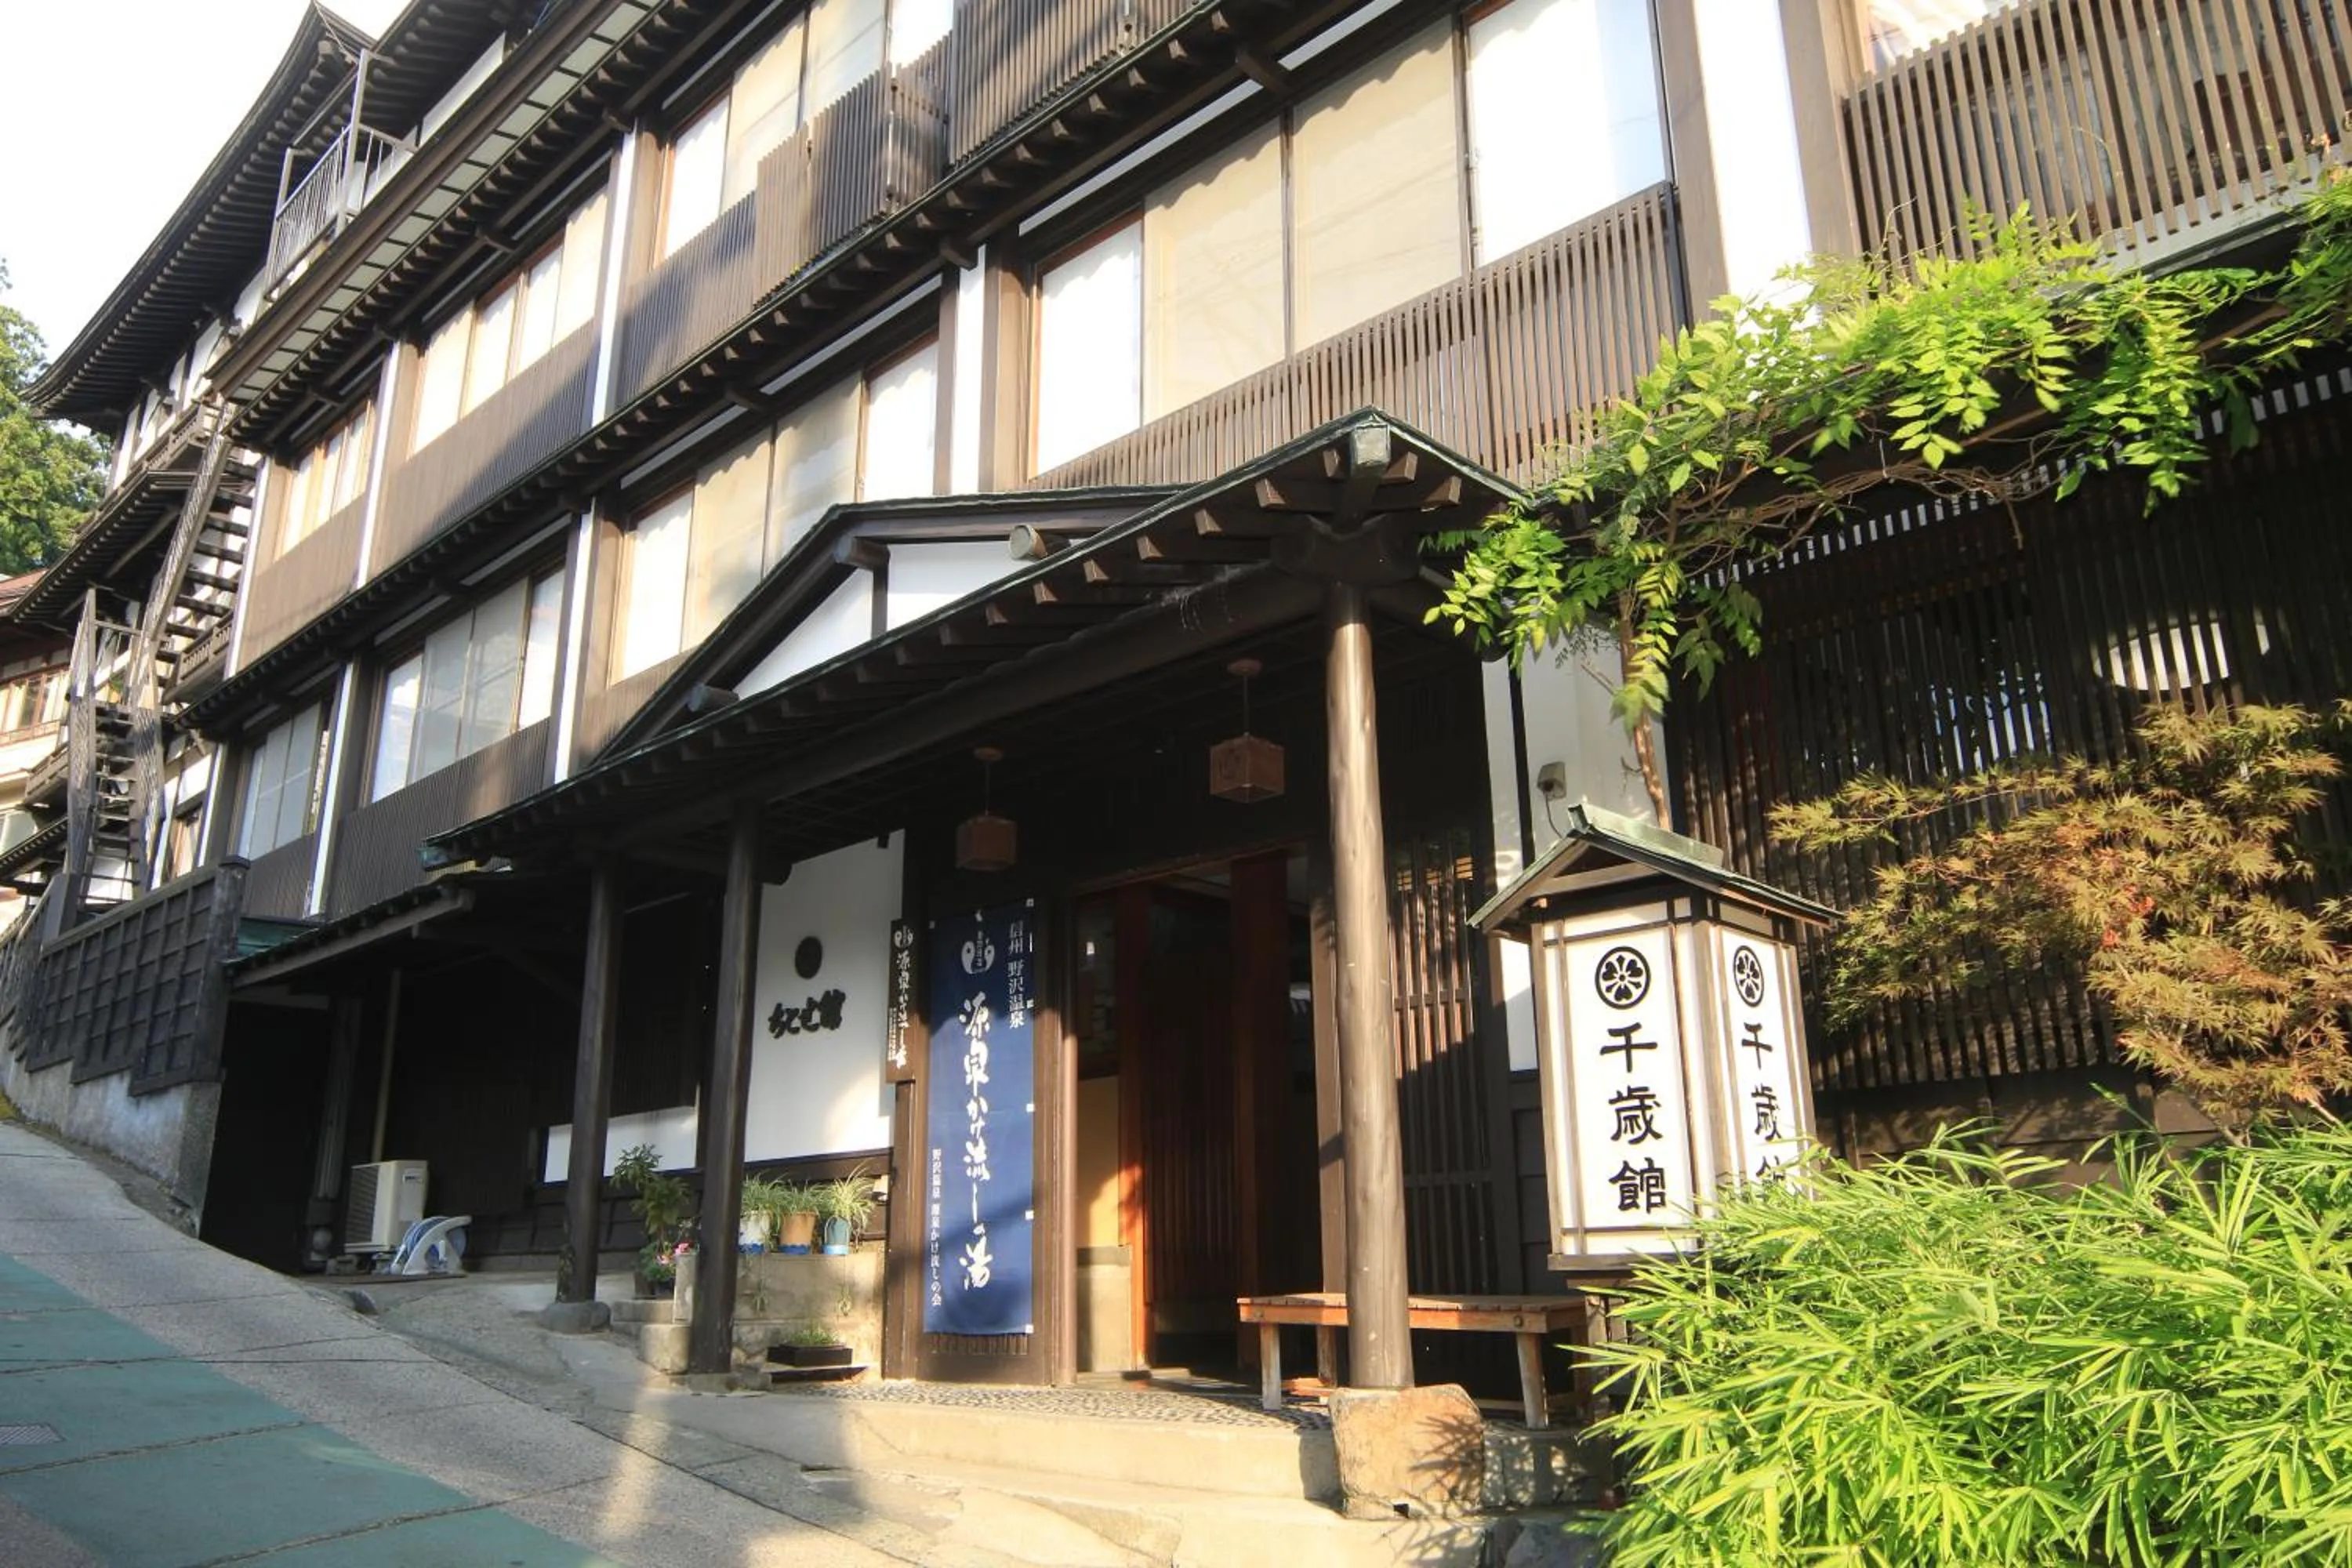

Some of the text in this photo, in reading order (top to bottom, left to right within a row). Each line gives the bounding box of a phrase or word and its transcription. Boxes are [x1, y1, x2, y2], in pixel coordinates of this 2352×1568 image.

[1007, 920, 1025, 1029] 信州 野沢温泉
[1599, 1022, 1667, 1213] 千歳館
